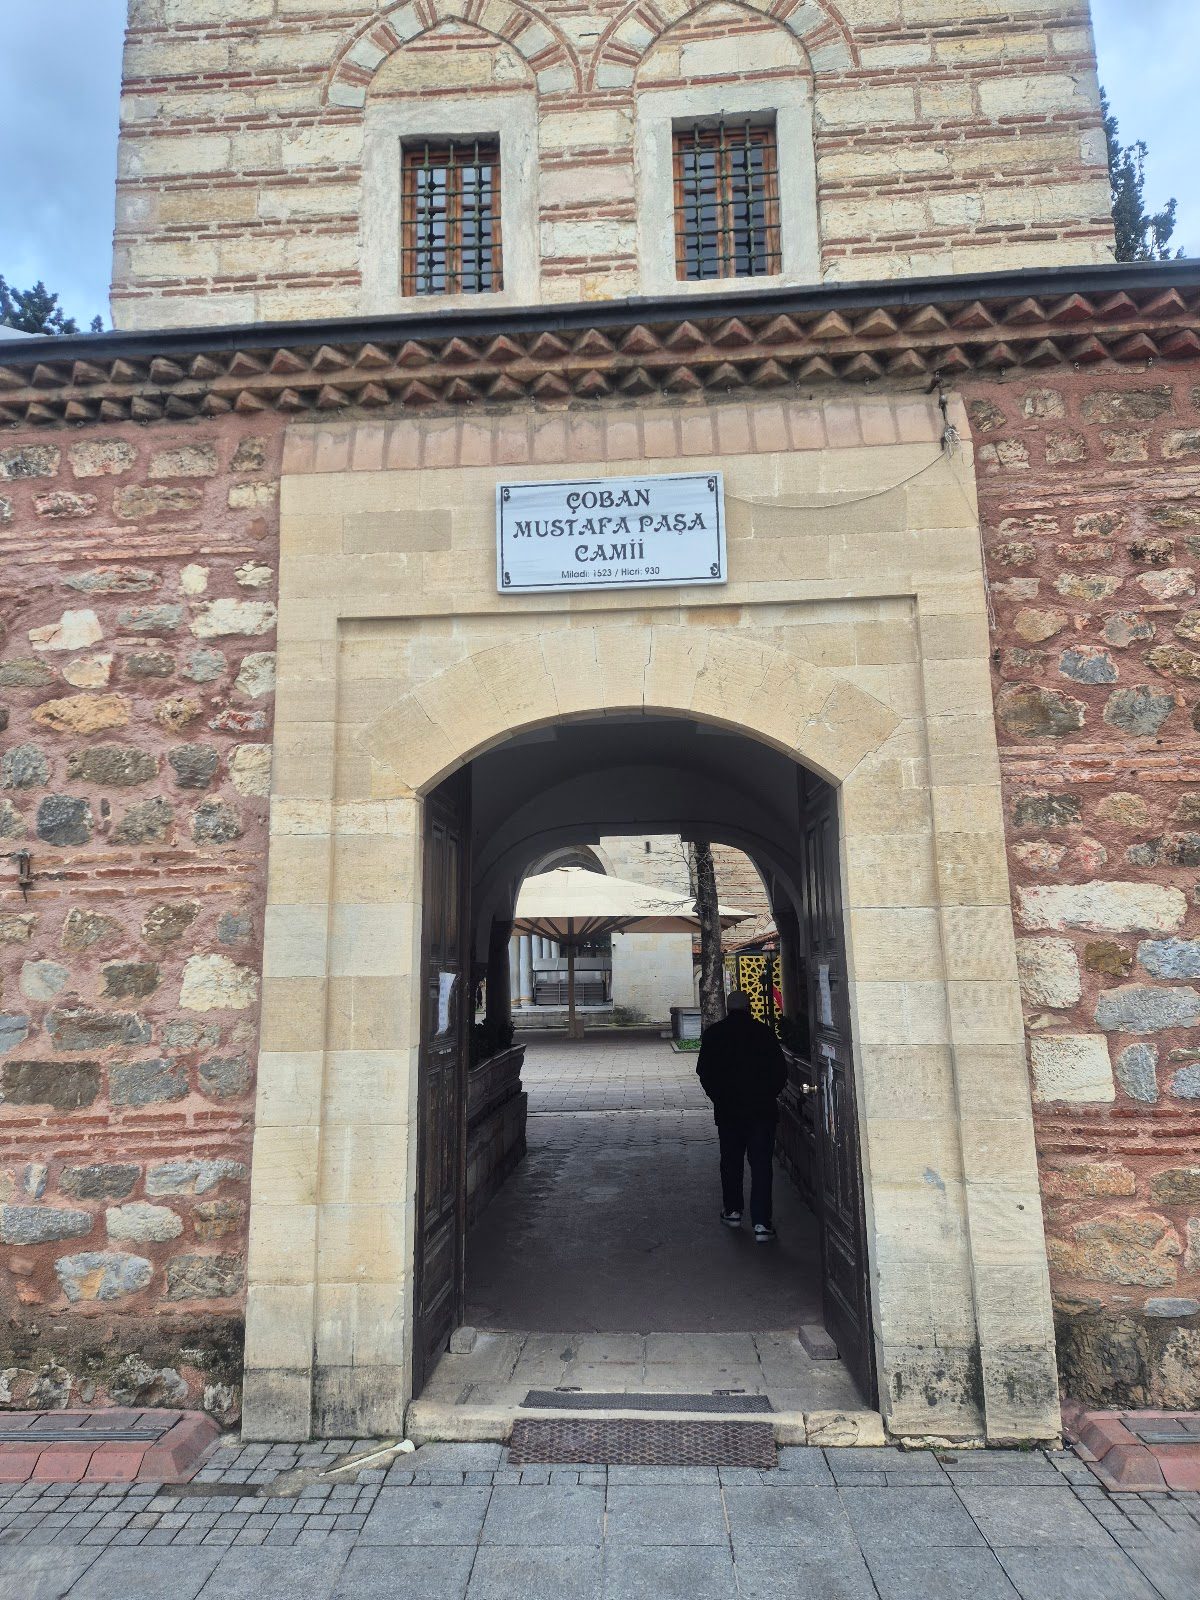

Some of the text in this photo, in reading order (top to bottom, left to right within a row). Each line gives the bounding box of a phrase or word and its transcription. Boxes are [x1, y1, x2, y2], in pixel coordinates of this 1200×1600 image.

[566, 488, 650, 514] ÇOBAN
[513, 512, 707, 538] MUSTAFA PAŞA
[575, 538, 644, 562] CAMİİ
[645, 566, 660, 575] 930
